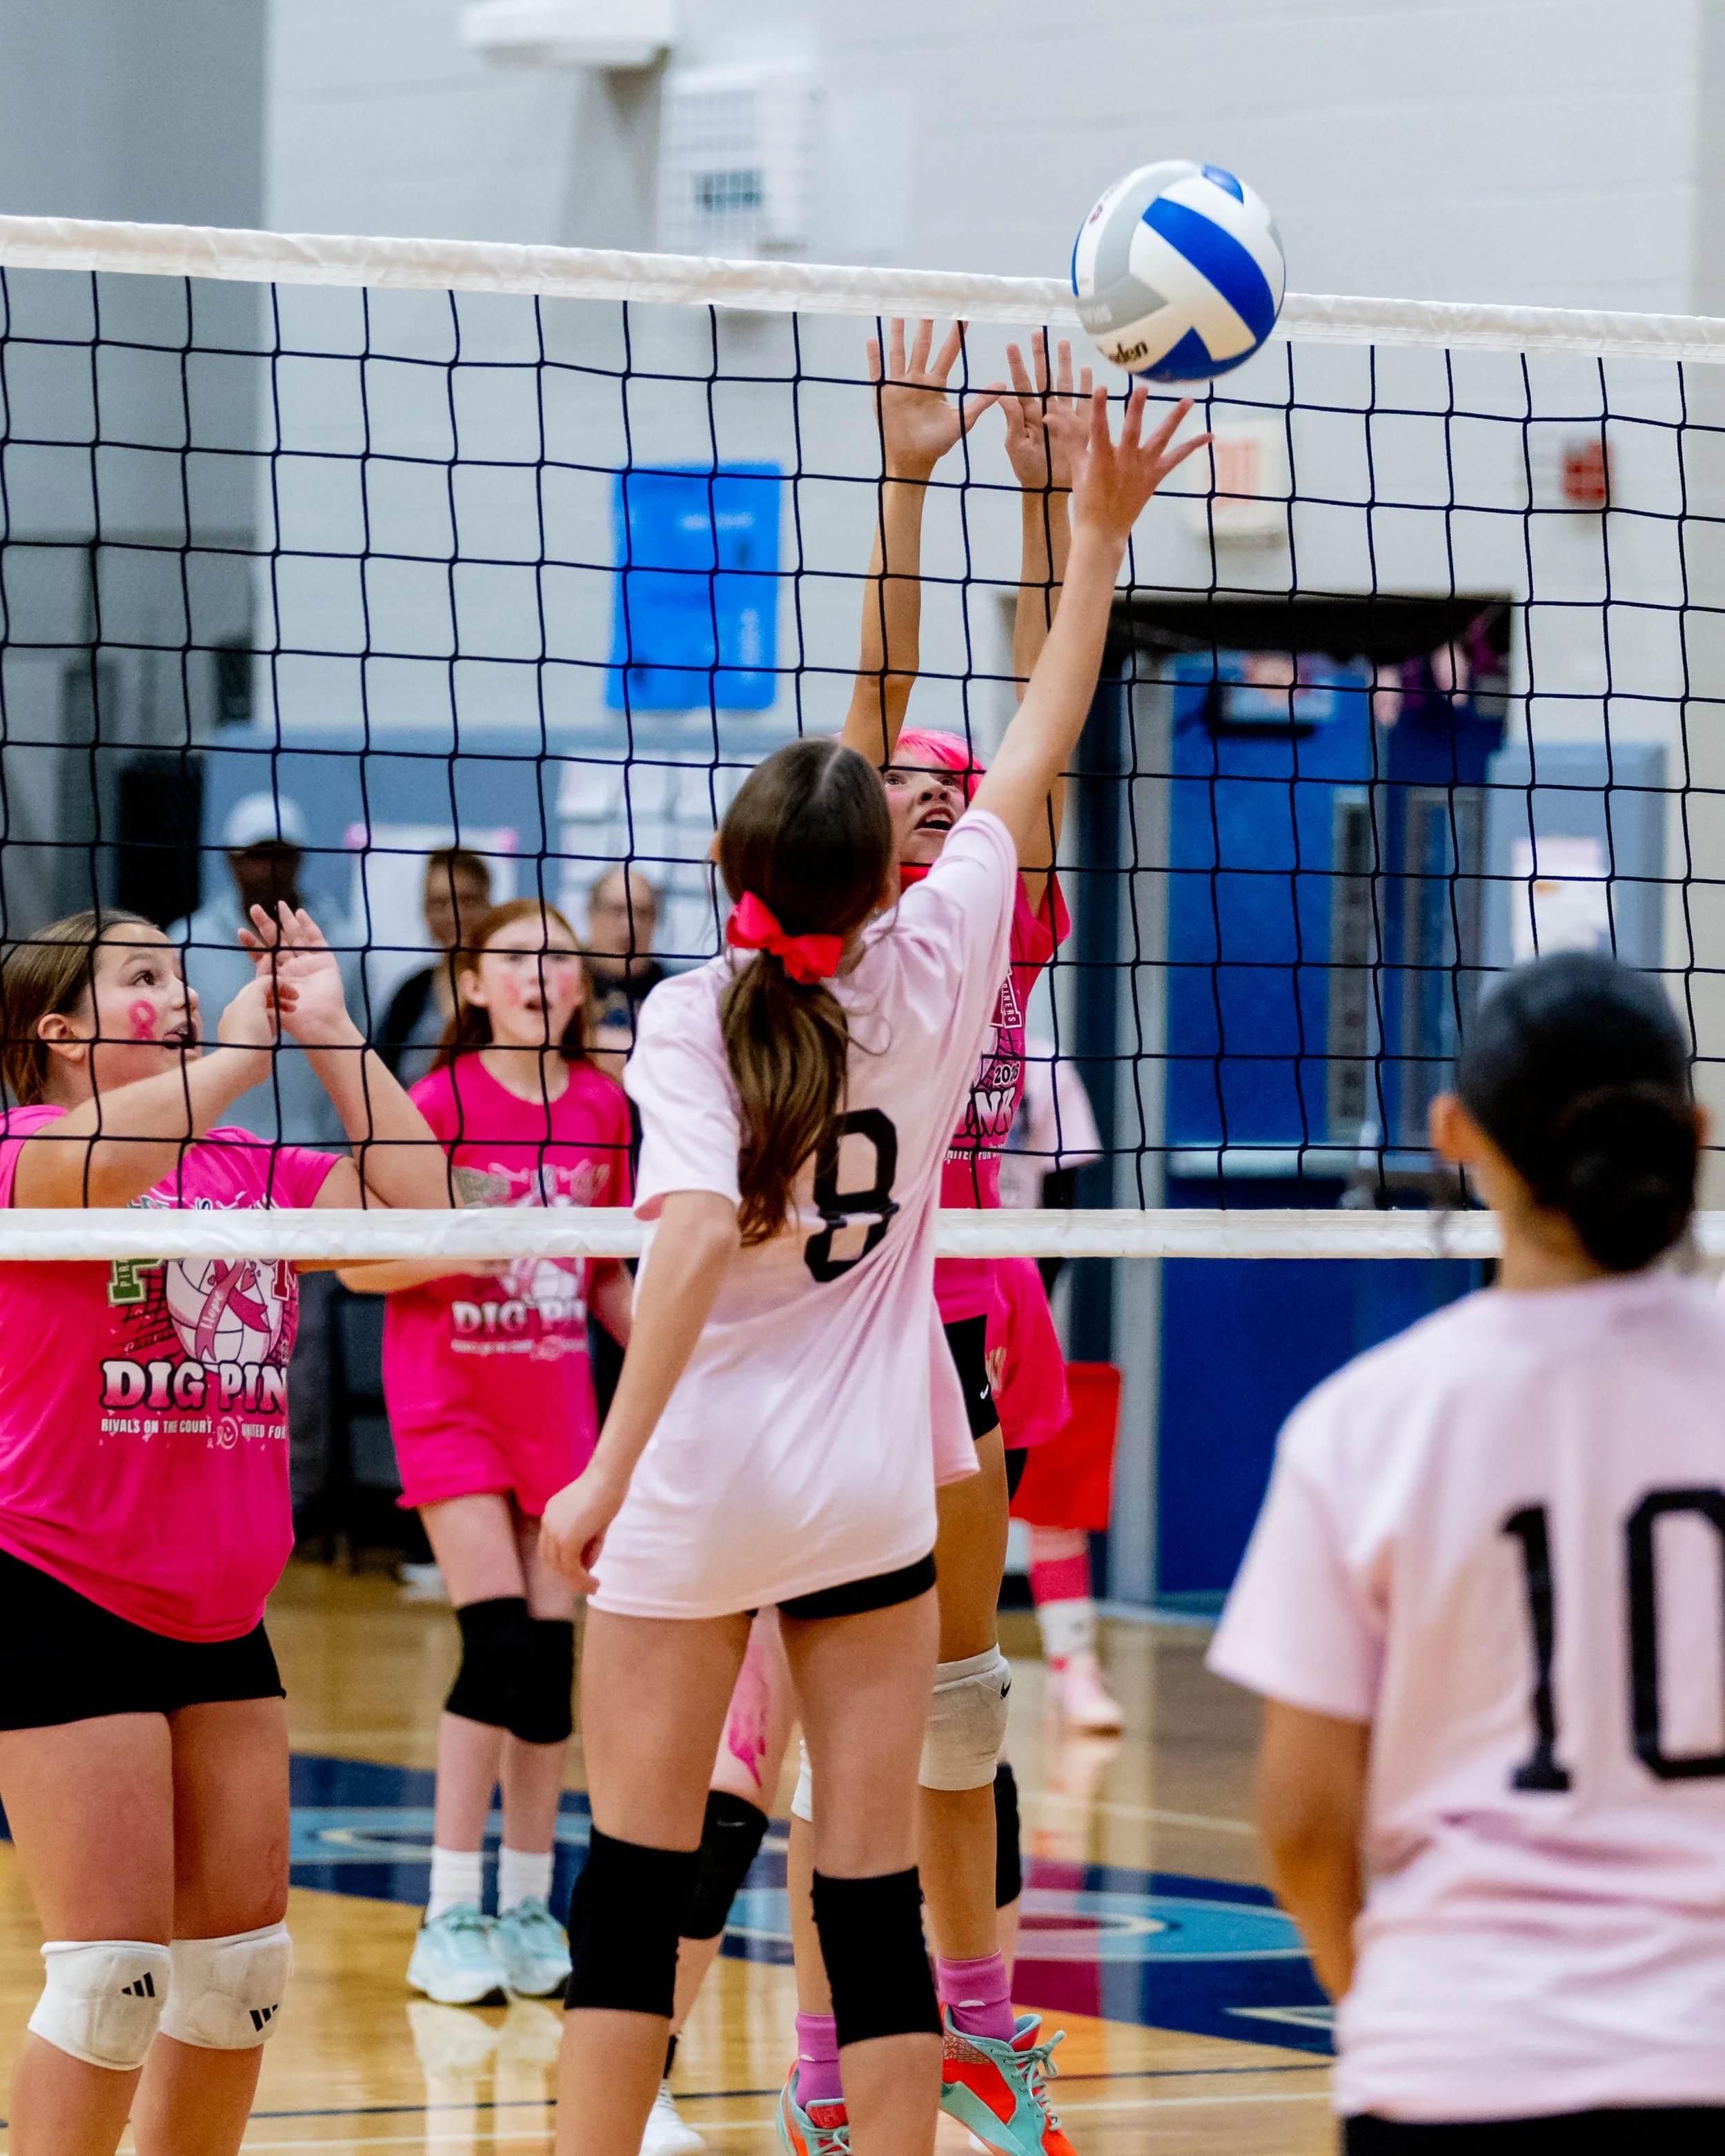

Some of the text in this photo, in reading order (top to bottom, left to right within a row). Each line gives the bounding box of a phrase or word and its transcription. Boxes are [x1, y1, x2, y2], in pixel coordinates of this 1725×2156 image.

[804, 1107, 900, 1283] 8
[101, 1358, 288, 1414] DIG PIN
[101, 1418, 140, 1433] RIVALS
[144, 1420, 159, 1433] ON
[163, 1420, 177, 1433] THE
[179, 1419, 213, 1434] COURT
[1501, 1485, 1725, 1792] 10
